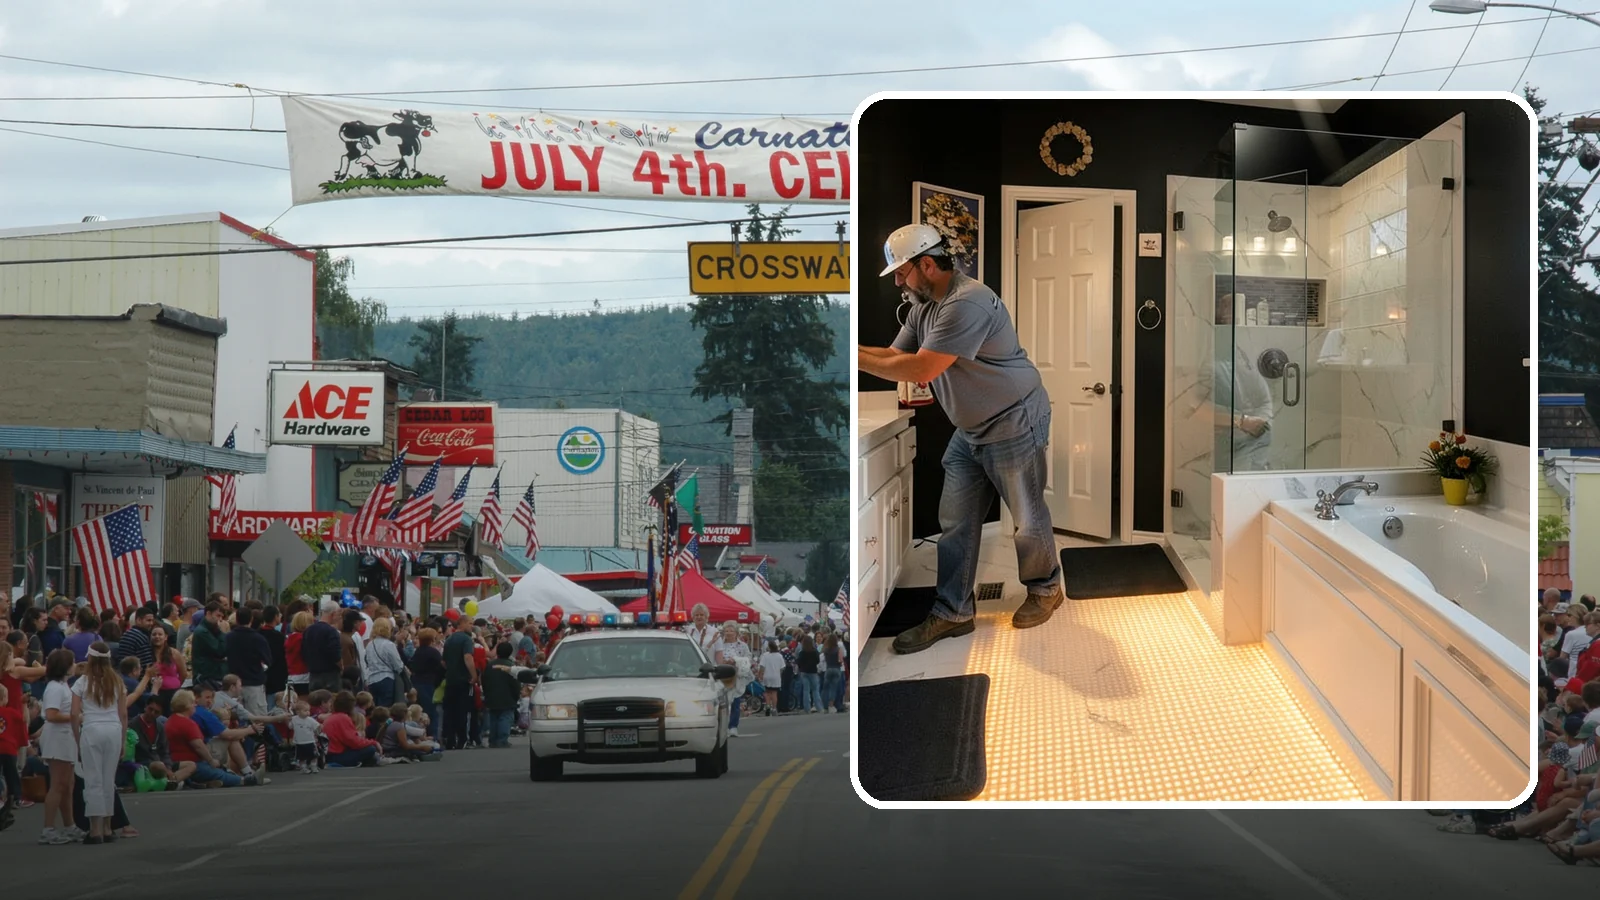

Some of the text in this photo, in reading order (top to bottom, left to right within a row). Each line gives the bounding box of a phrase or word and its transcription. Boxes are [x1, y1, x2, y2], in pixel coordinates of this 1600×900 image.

[481, 141, 604, 192] JULY
[633, 150, 747, 198] 4th.
[697, 254, 850, 280] CROSSWA
[283, 380, 373, 420] ACE
[405, 409, 452, 421] CEDAR
[283, 421, 371, 437] Hardware
[416, 428, 477, 447] Coca-Cola
[354, 467, 384, 479] Simpl
[95, 485, 124, 494] Vincent
[126, 485, 136, 494] de
[138, 486, 155, 495] Paul
[688, 526, 741, 535] CRNATION
[699, 535, 730, 544] GLASS
